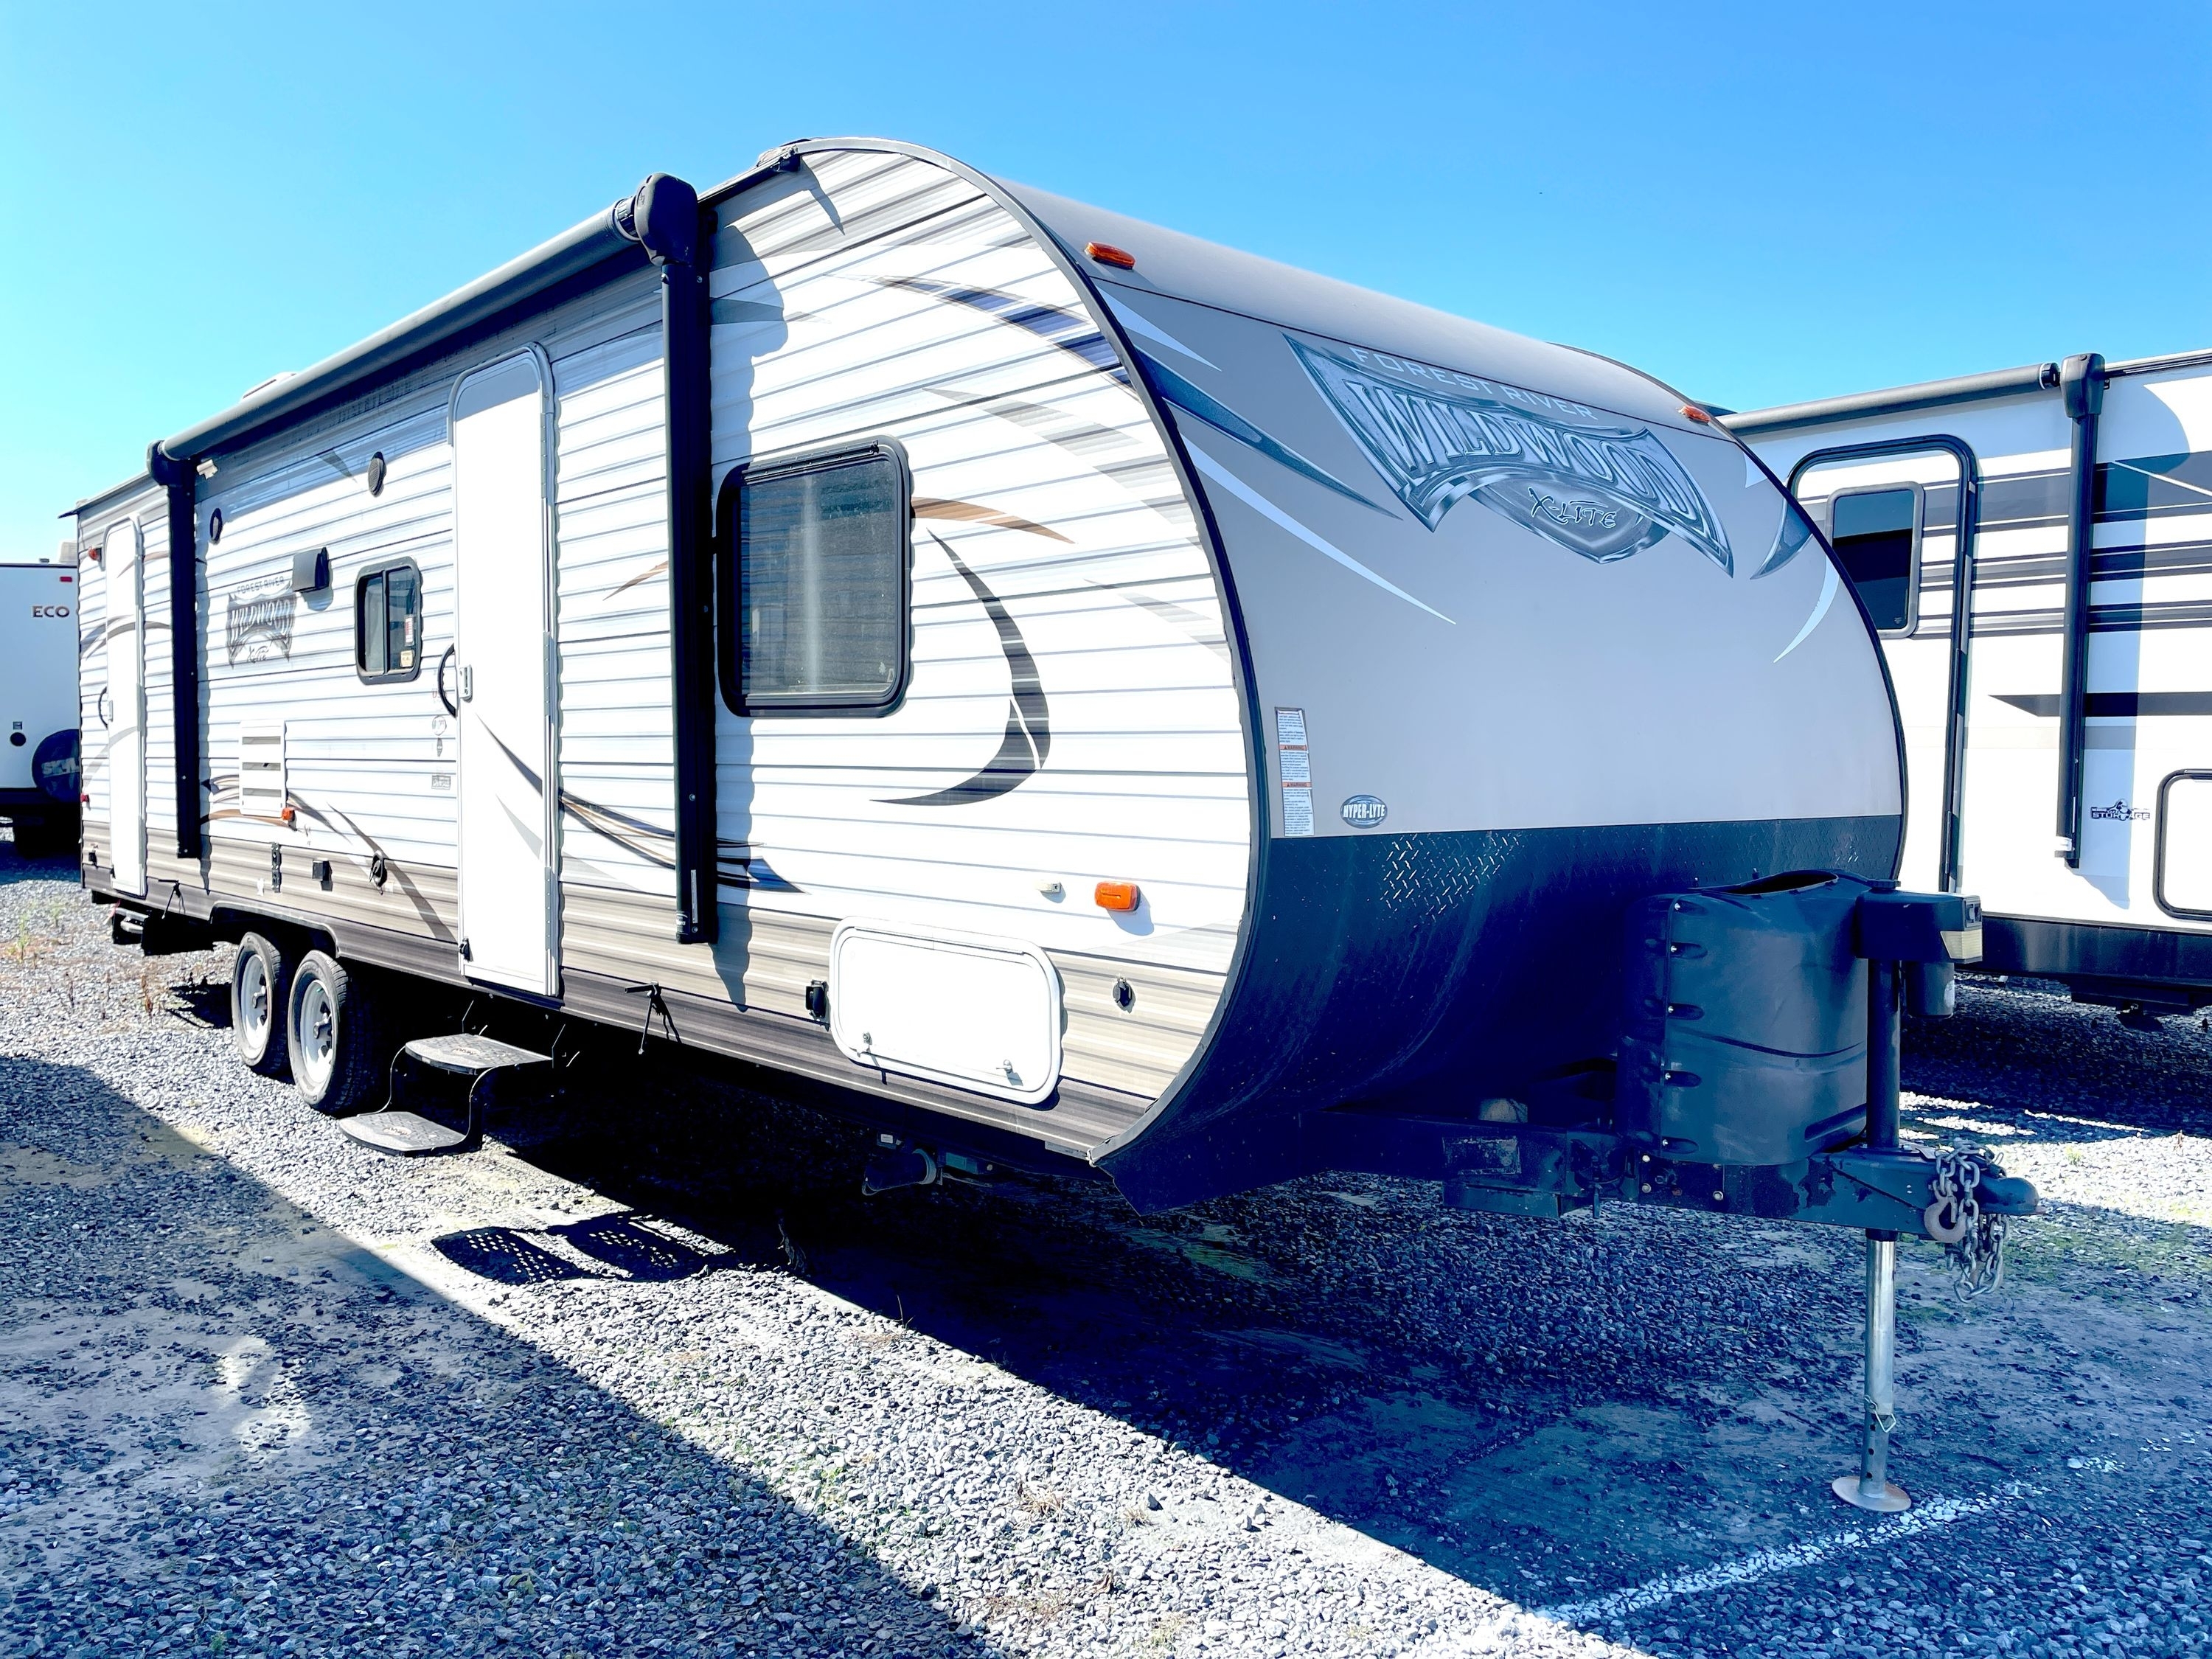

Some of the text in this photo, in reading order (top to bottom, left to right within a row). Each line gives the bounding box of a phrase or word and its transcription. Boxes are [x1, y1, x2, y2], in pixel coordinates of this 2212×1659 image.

[1349, 347, 1599, 420] FOREST RIVER
[1343, 380, 1694, 516] WILDWOOD
[32, 605, 70, 618] ECO
[1343, 803, 1385, 818] HYPER-LYTE
